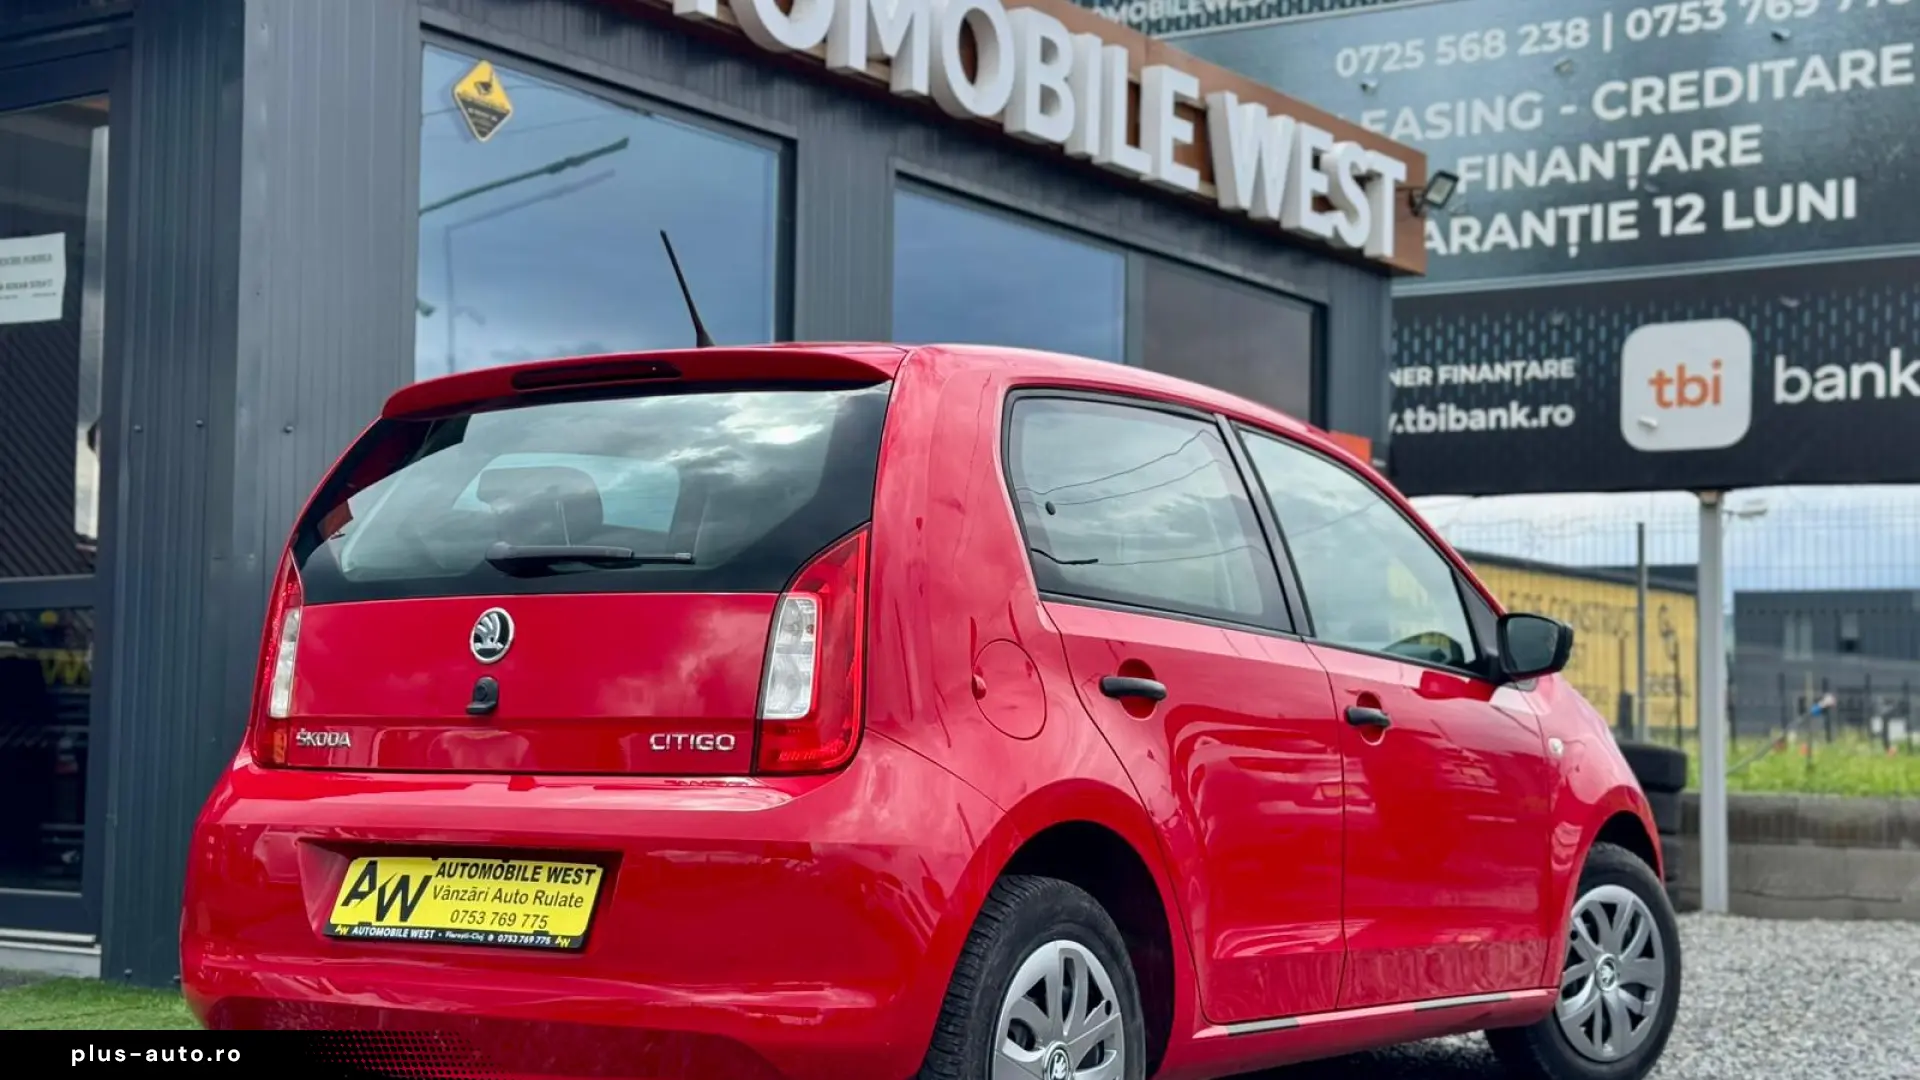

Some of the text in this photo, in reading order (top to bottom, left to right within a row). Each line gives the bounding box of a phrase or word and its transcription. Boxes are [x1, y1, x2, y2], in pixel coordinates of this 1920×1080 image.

[1336, 39, 1425, 78] 0725
[1435, 28, 1507, 66] 568
[1517, 17, 1590, 56] 238
[1625, 0, 1727, 41] 0753
[1340, 91, 1545, 141] EASING
[1592, 43, 1914, 121] CREDITARE
[673, 0, 1407, 259] MOBILE WEST
[1456, 124, 1763, 193] FINANȚARE
[1653, 194, 1706, 237] 12
[1722, 177, 1857, 232] LUNI
[1438, 357, 1576, 387] FINANȚARE
[1647, 347, 1920, 409] tbi bank
[295, 727, 352, 747] ŠKODA
[649, 732, 736, 751] CITIGO
[341, 860, 433, 923] AW
[435, 861, 597, 886] AUTOMOBILE WEST
[450, 909, 550, 930] 0753 769 775
[491, 887, 529, 905] Auto
[533, 890, 585, 909] Rulate
[351, 926, 409, 938] AUTOMOBILE
[410, 929, 437, 939] WEST
